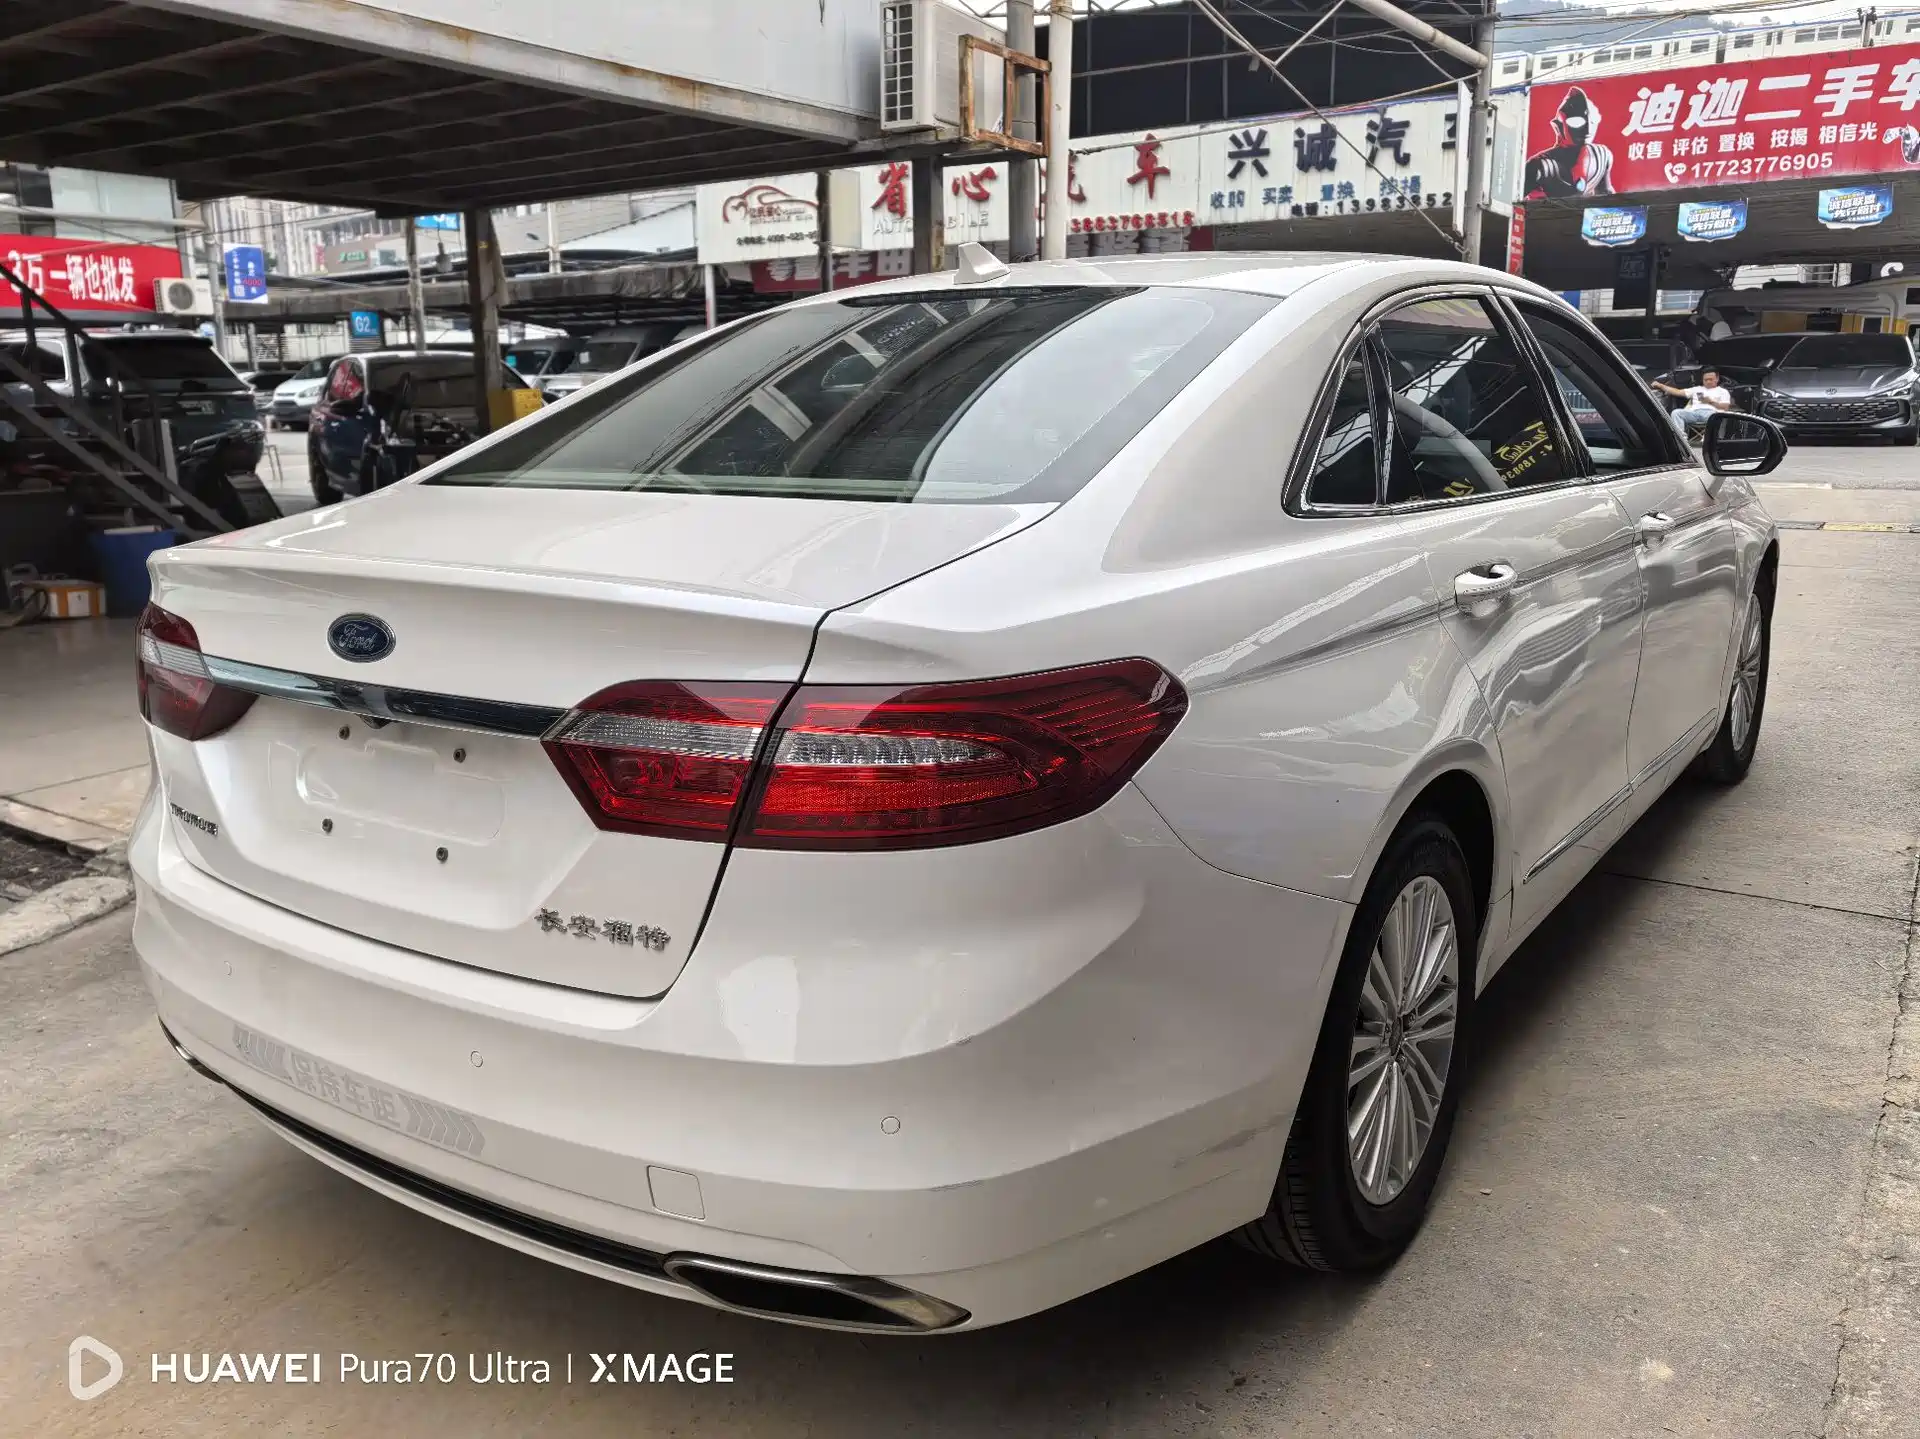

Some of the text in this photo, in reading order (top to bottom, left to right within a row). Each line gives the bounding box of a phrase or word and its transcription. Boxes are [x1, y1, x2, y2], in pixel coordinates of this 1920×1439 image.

[1621, 58, 1920, 136] 迪迦二手车
[1628, 121, 1878, 161] 收售 评估 置换 按揭 相信光
[1691, 152, 1833, 178] 17723776905
[533, 907, 672, 951] 长安福特
